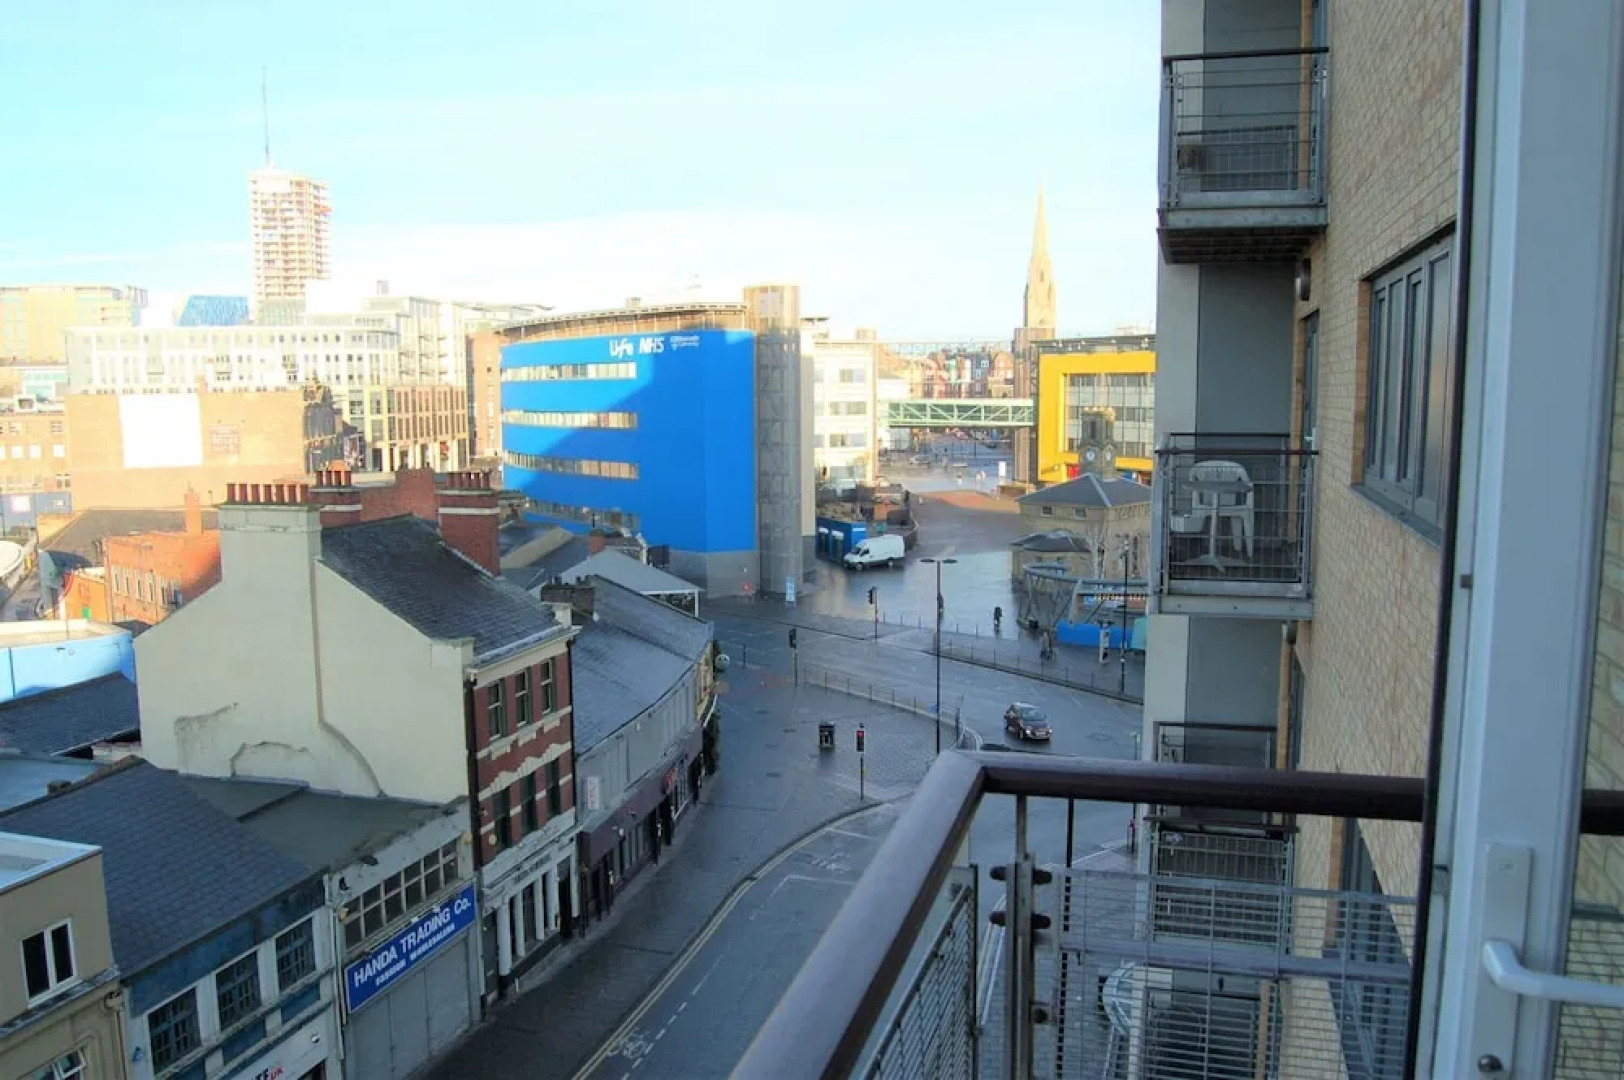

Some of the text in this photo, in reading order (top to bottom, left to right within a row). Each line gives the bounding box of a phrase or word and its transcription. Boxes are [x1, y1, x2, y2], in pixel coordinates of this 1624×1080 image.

[639, 338, 664, 354] NHS
[354, 898, 471, 987] HANDA TRADING Co.
